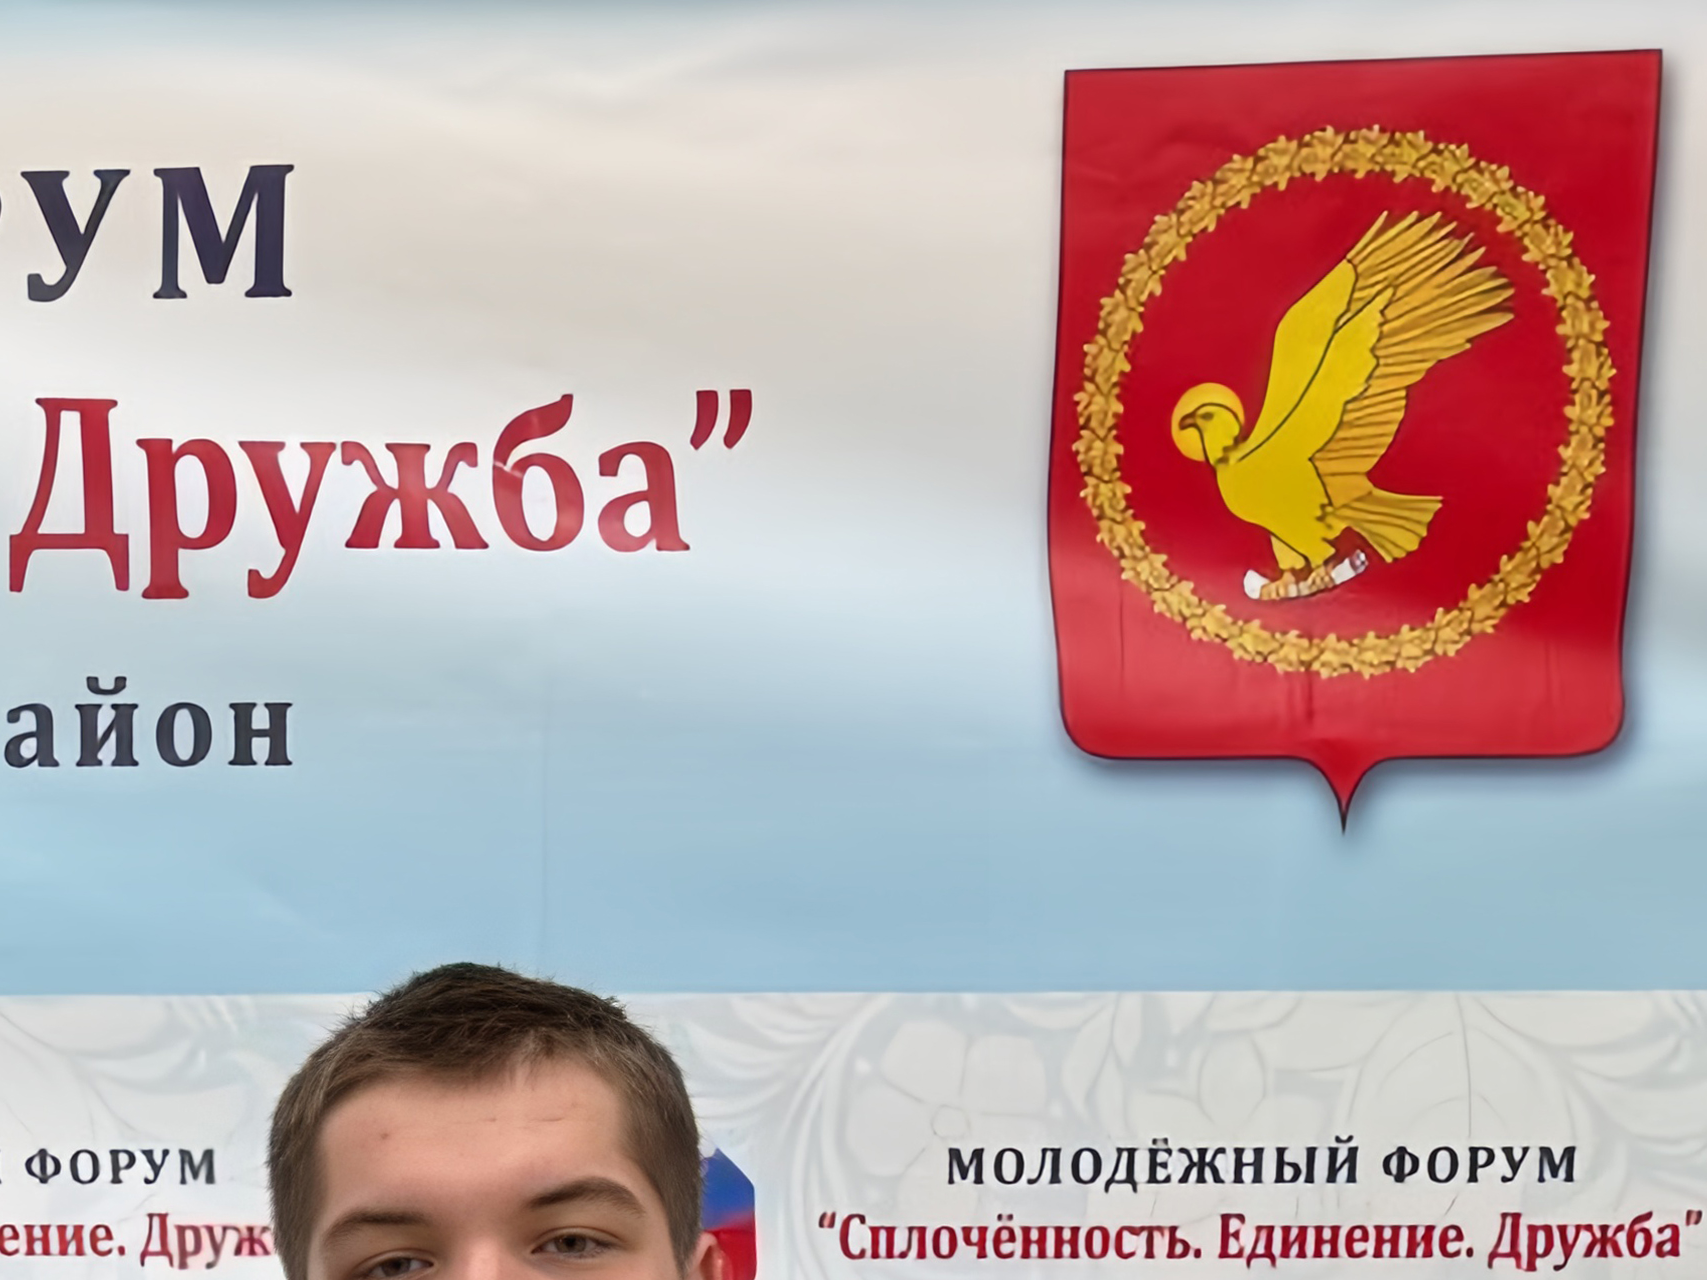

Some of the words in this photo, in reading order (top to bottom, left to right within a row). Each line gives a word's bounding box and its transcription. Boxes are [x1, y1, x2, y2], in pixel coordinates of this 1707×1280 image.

[25, 1149, 215, 1185] ФОРУМ
[948, 1135, 1358, 1193] МОЛОДЁЖНЫЙ
[1383, 1146, 1576, 1183] ФОРУМ
[140, 1212, 272, 1270] Друж
[1218, 1214, 1473, 1268] Единение.
